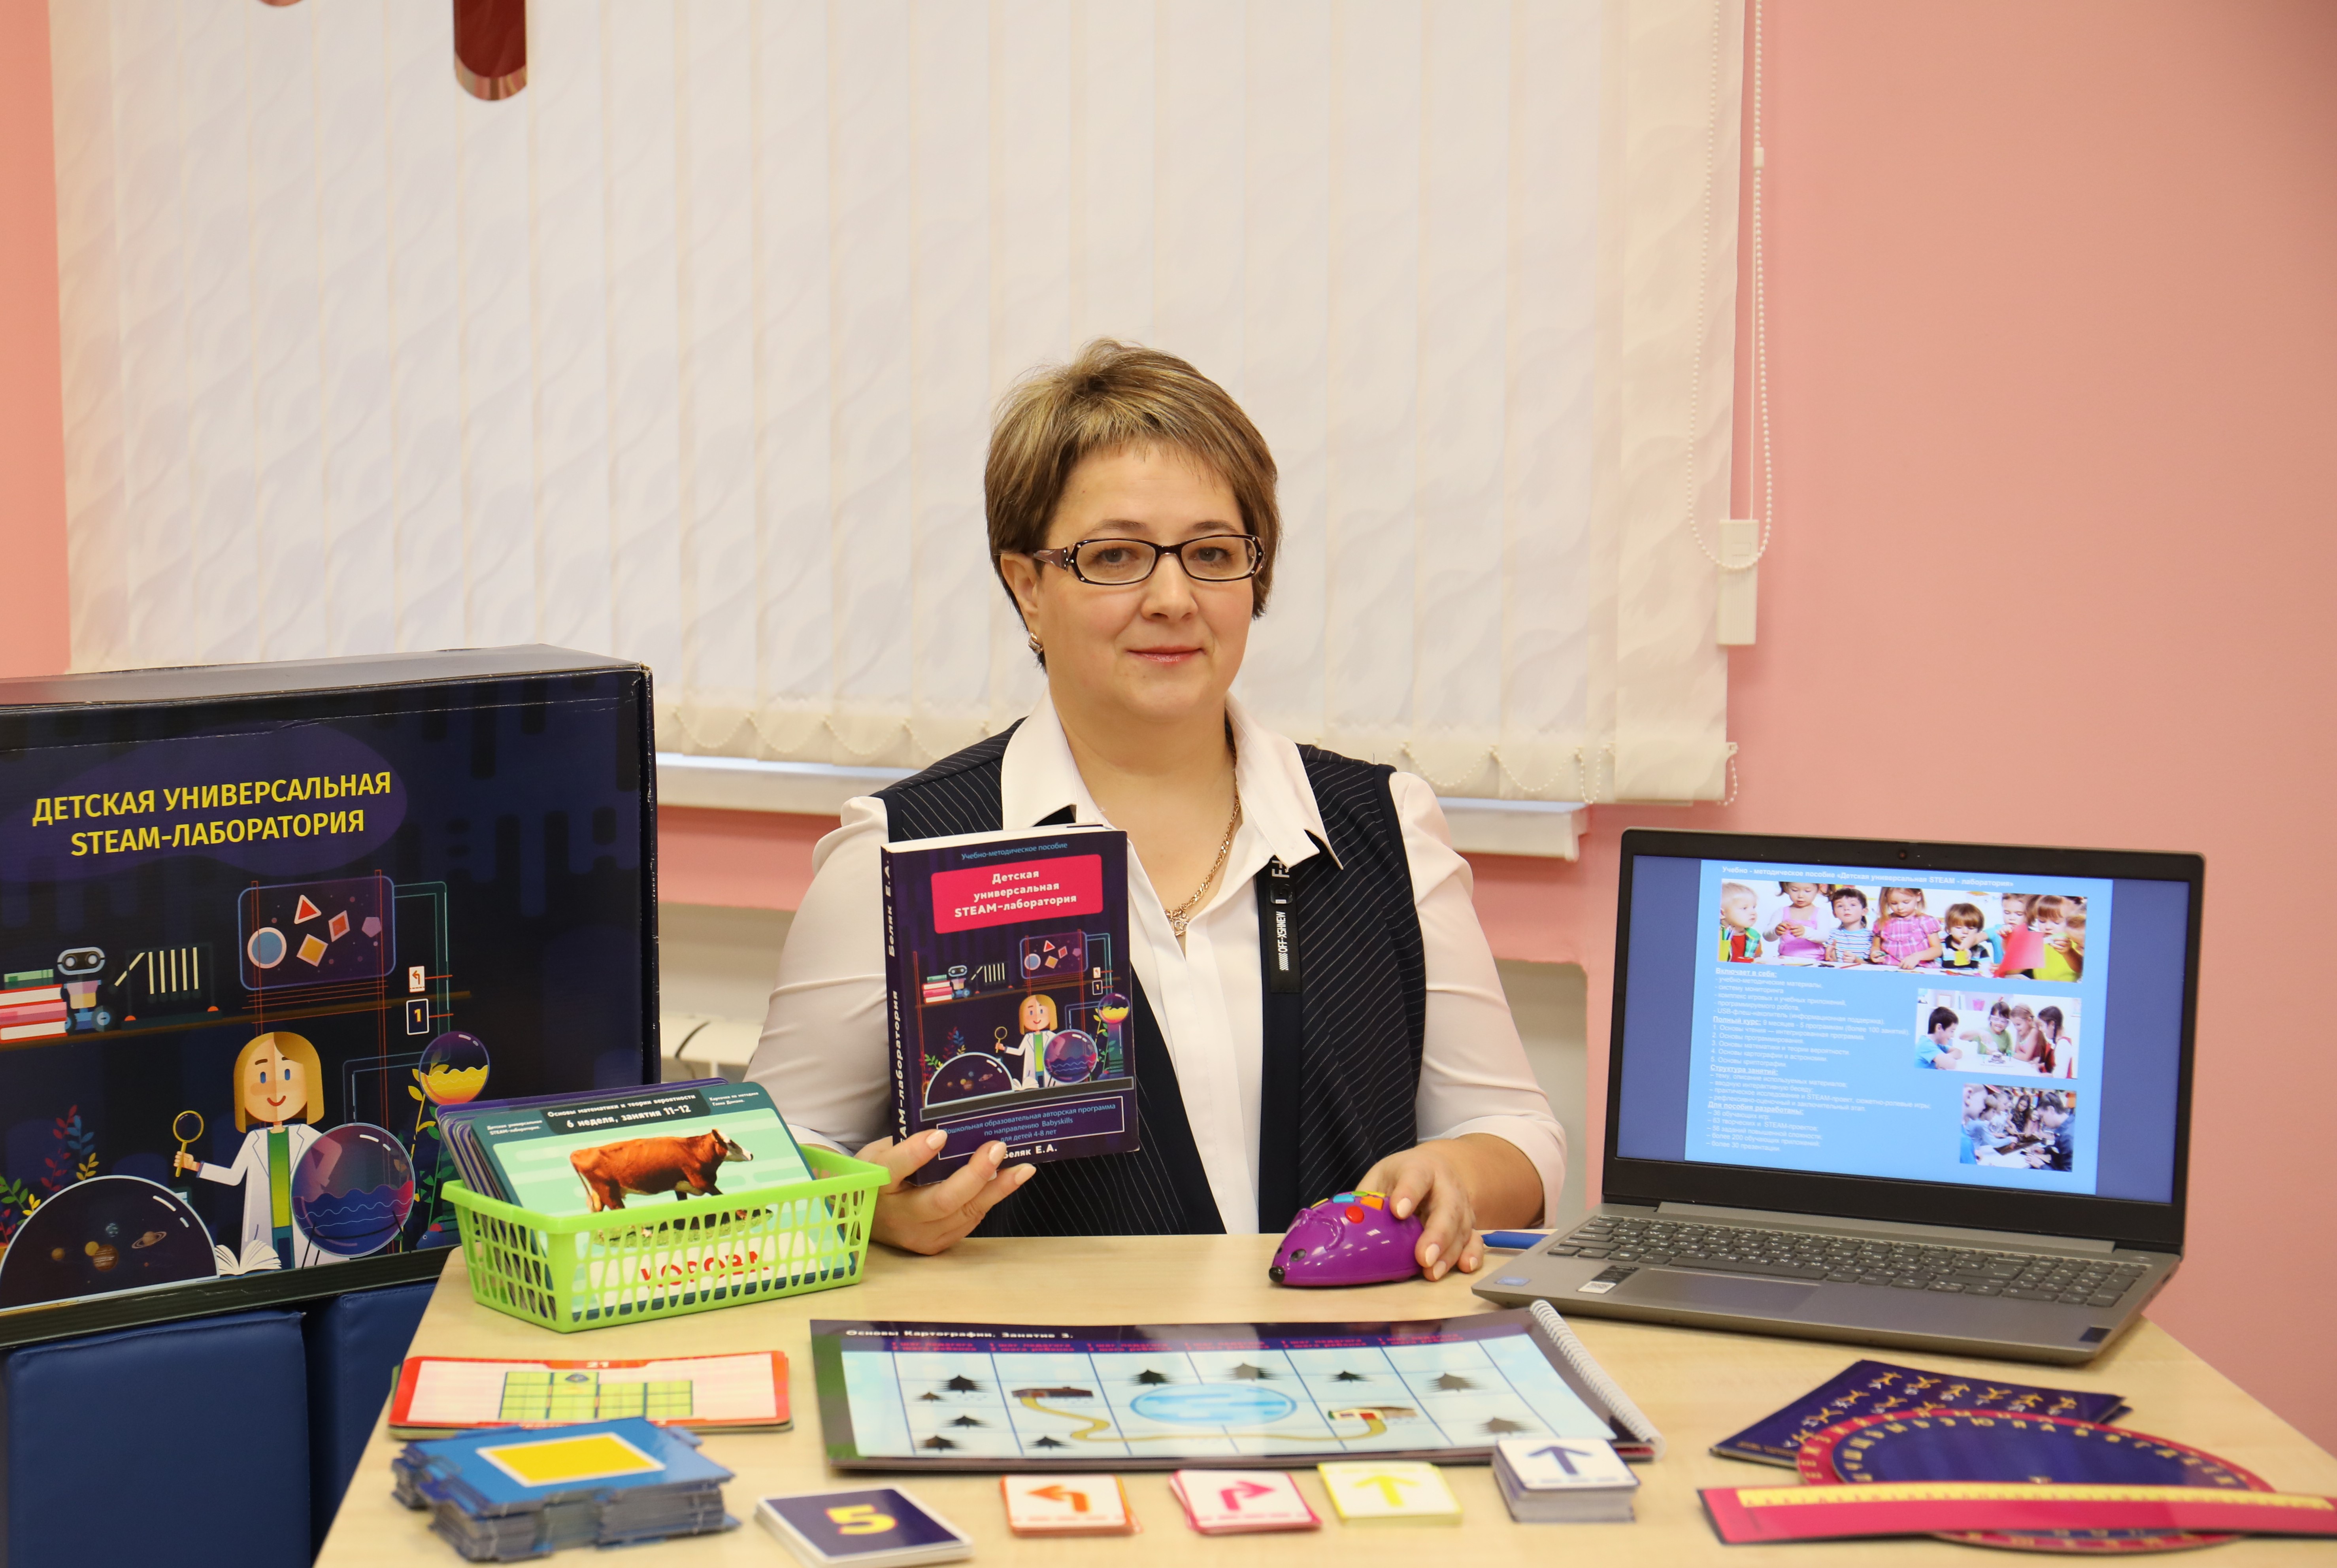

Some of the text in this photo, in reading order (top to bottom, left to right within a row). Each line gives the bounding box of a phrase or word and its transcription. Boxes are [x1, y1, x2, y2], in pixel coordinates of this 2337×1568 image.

[32, 771, 391, 826] ДЕТСКАЯ УНИВЕРСАЛЬНАЯ
[70, 809, 364, 857] STEAM-ЛАБОРАТОРИЯ
[961, 842, 1068, 860] Учебно-методическое пособие
[992, 871, 1039, 885] Детская
[1754, 868, 1803, 877] методическое
[1871, 874, 1927, 883] универсальная
[973, 883, 1060, 902] универсальная
[954, 895, 1077, 917] STEAM-лаборатория
[1275, 911, 1288, 953] OFF-XSHNEW
[414, 1008, 422, 1022] 1
[892, 991, 907, 1142] AM-лаборатория
[577, 1105, 619, 1114] математики
[653, 1094, 696, 1104] вероятности
[566, 1105, 692, 1128] 6 неделя, занятия 11-12
[984, 1113, 1041, 1127] образовательная
[1042, 1108, 1077, 1119] авторская
[1078, 1104, 1116, 1115] программа
[994, 1123, 1039, 1134] направлению
[1041, 1117, 1073, 1128] Babyskills
[1013, 1132, 1032, 1141] детей
[825, 1504, 898, 1535] 5
